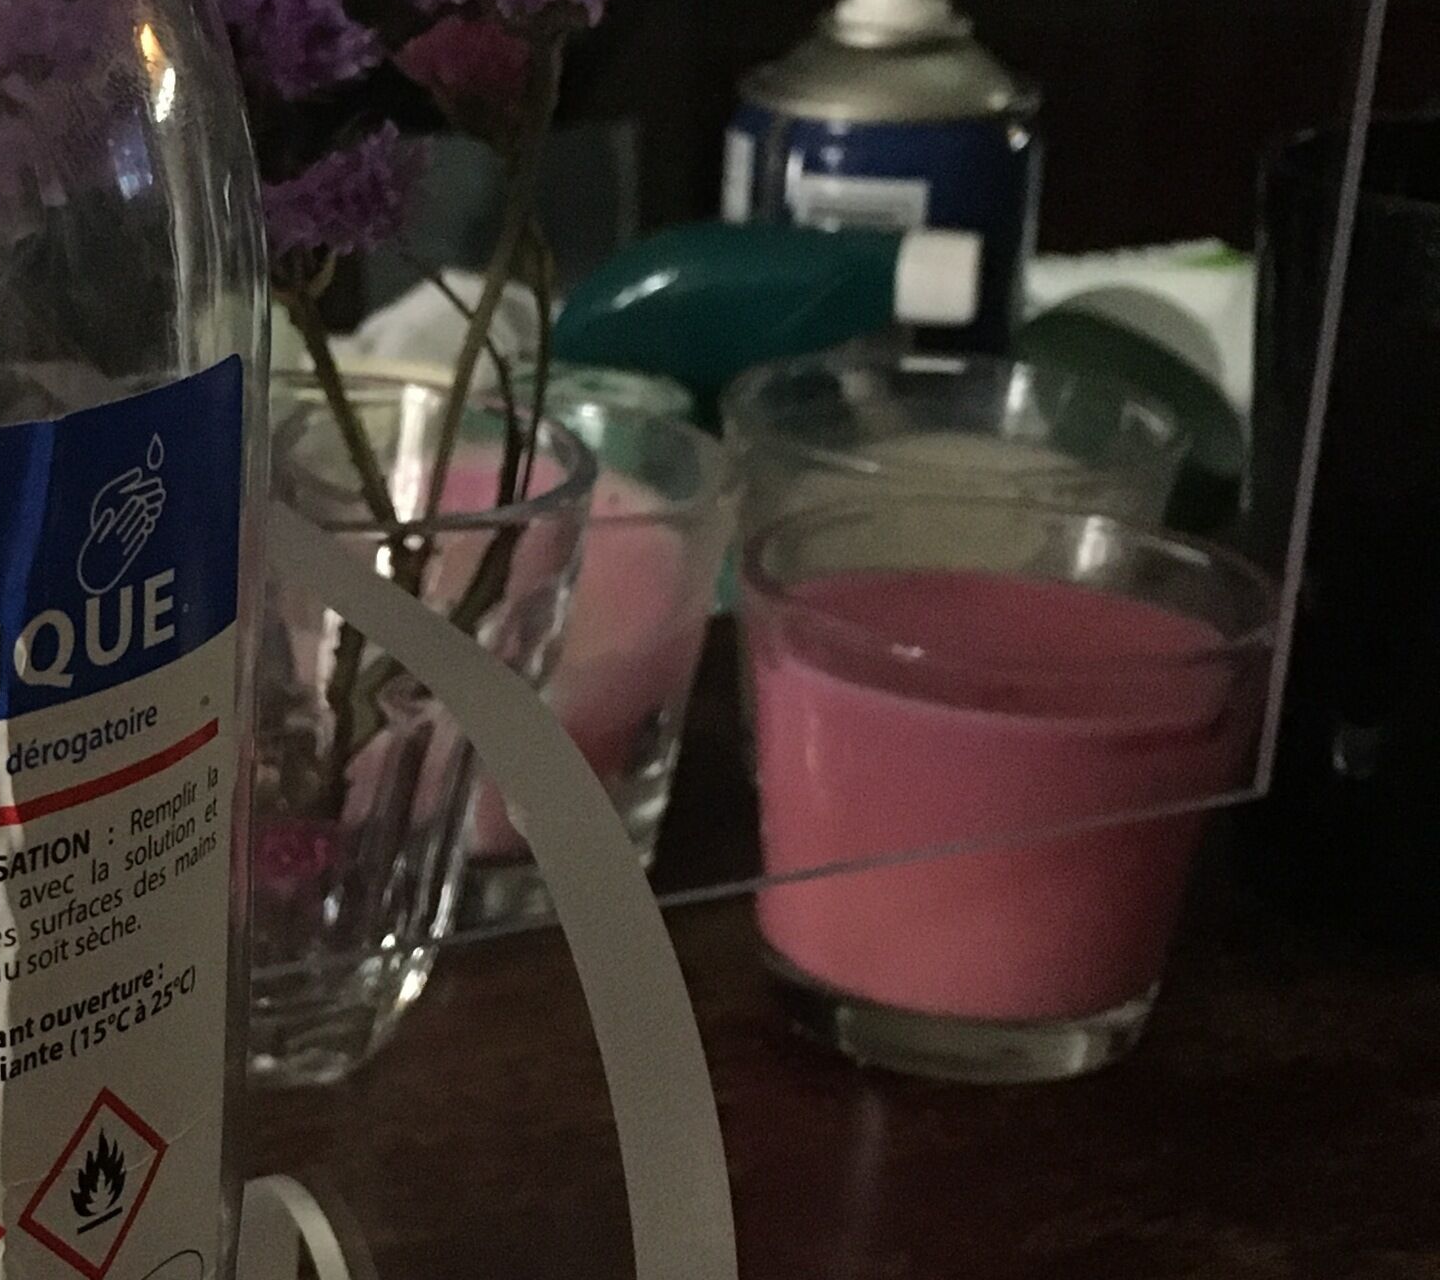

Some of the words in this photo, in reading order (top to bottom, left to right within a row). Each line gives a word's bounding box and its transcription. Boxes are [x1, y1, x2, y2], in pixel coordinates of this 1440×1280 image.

[6, 704, 158, 776] dérogatoire
[130, 781, 198, 835] Remplir
[20, 873, 75, 910] avec
[92, 859, 109, 886] la
[125, 817, 196, 872] solution
[205, 799, 219, 823] et
[31, 891, 123, 941] surfaces
[134, 861, 166, 899] des
[174, 829, 217, 876] mains
[27, 939, 69, 975] soit
[75, 910, 142, 957] sèche.
[134, 999, 146, 1024] à
